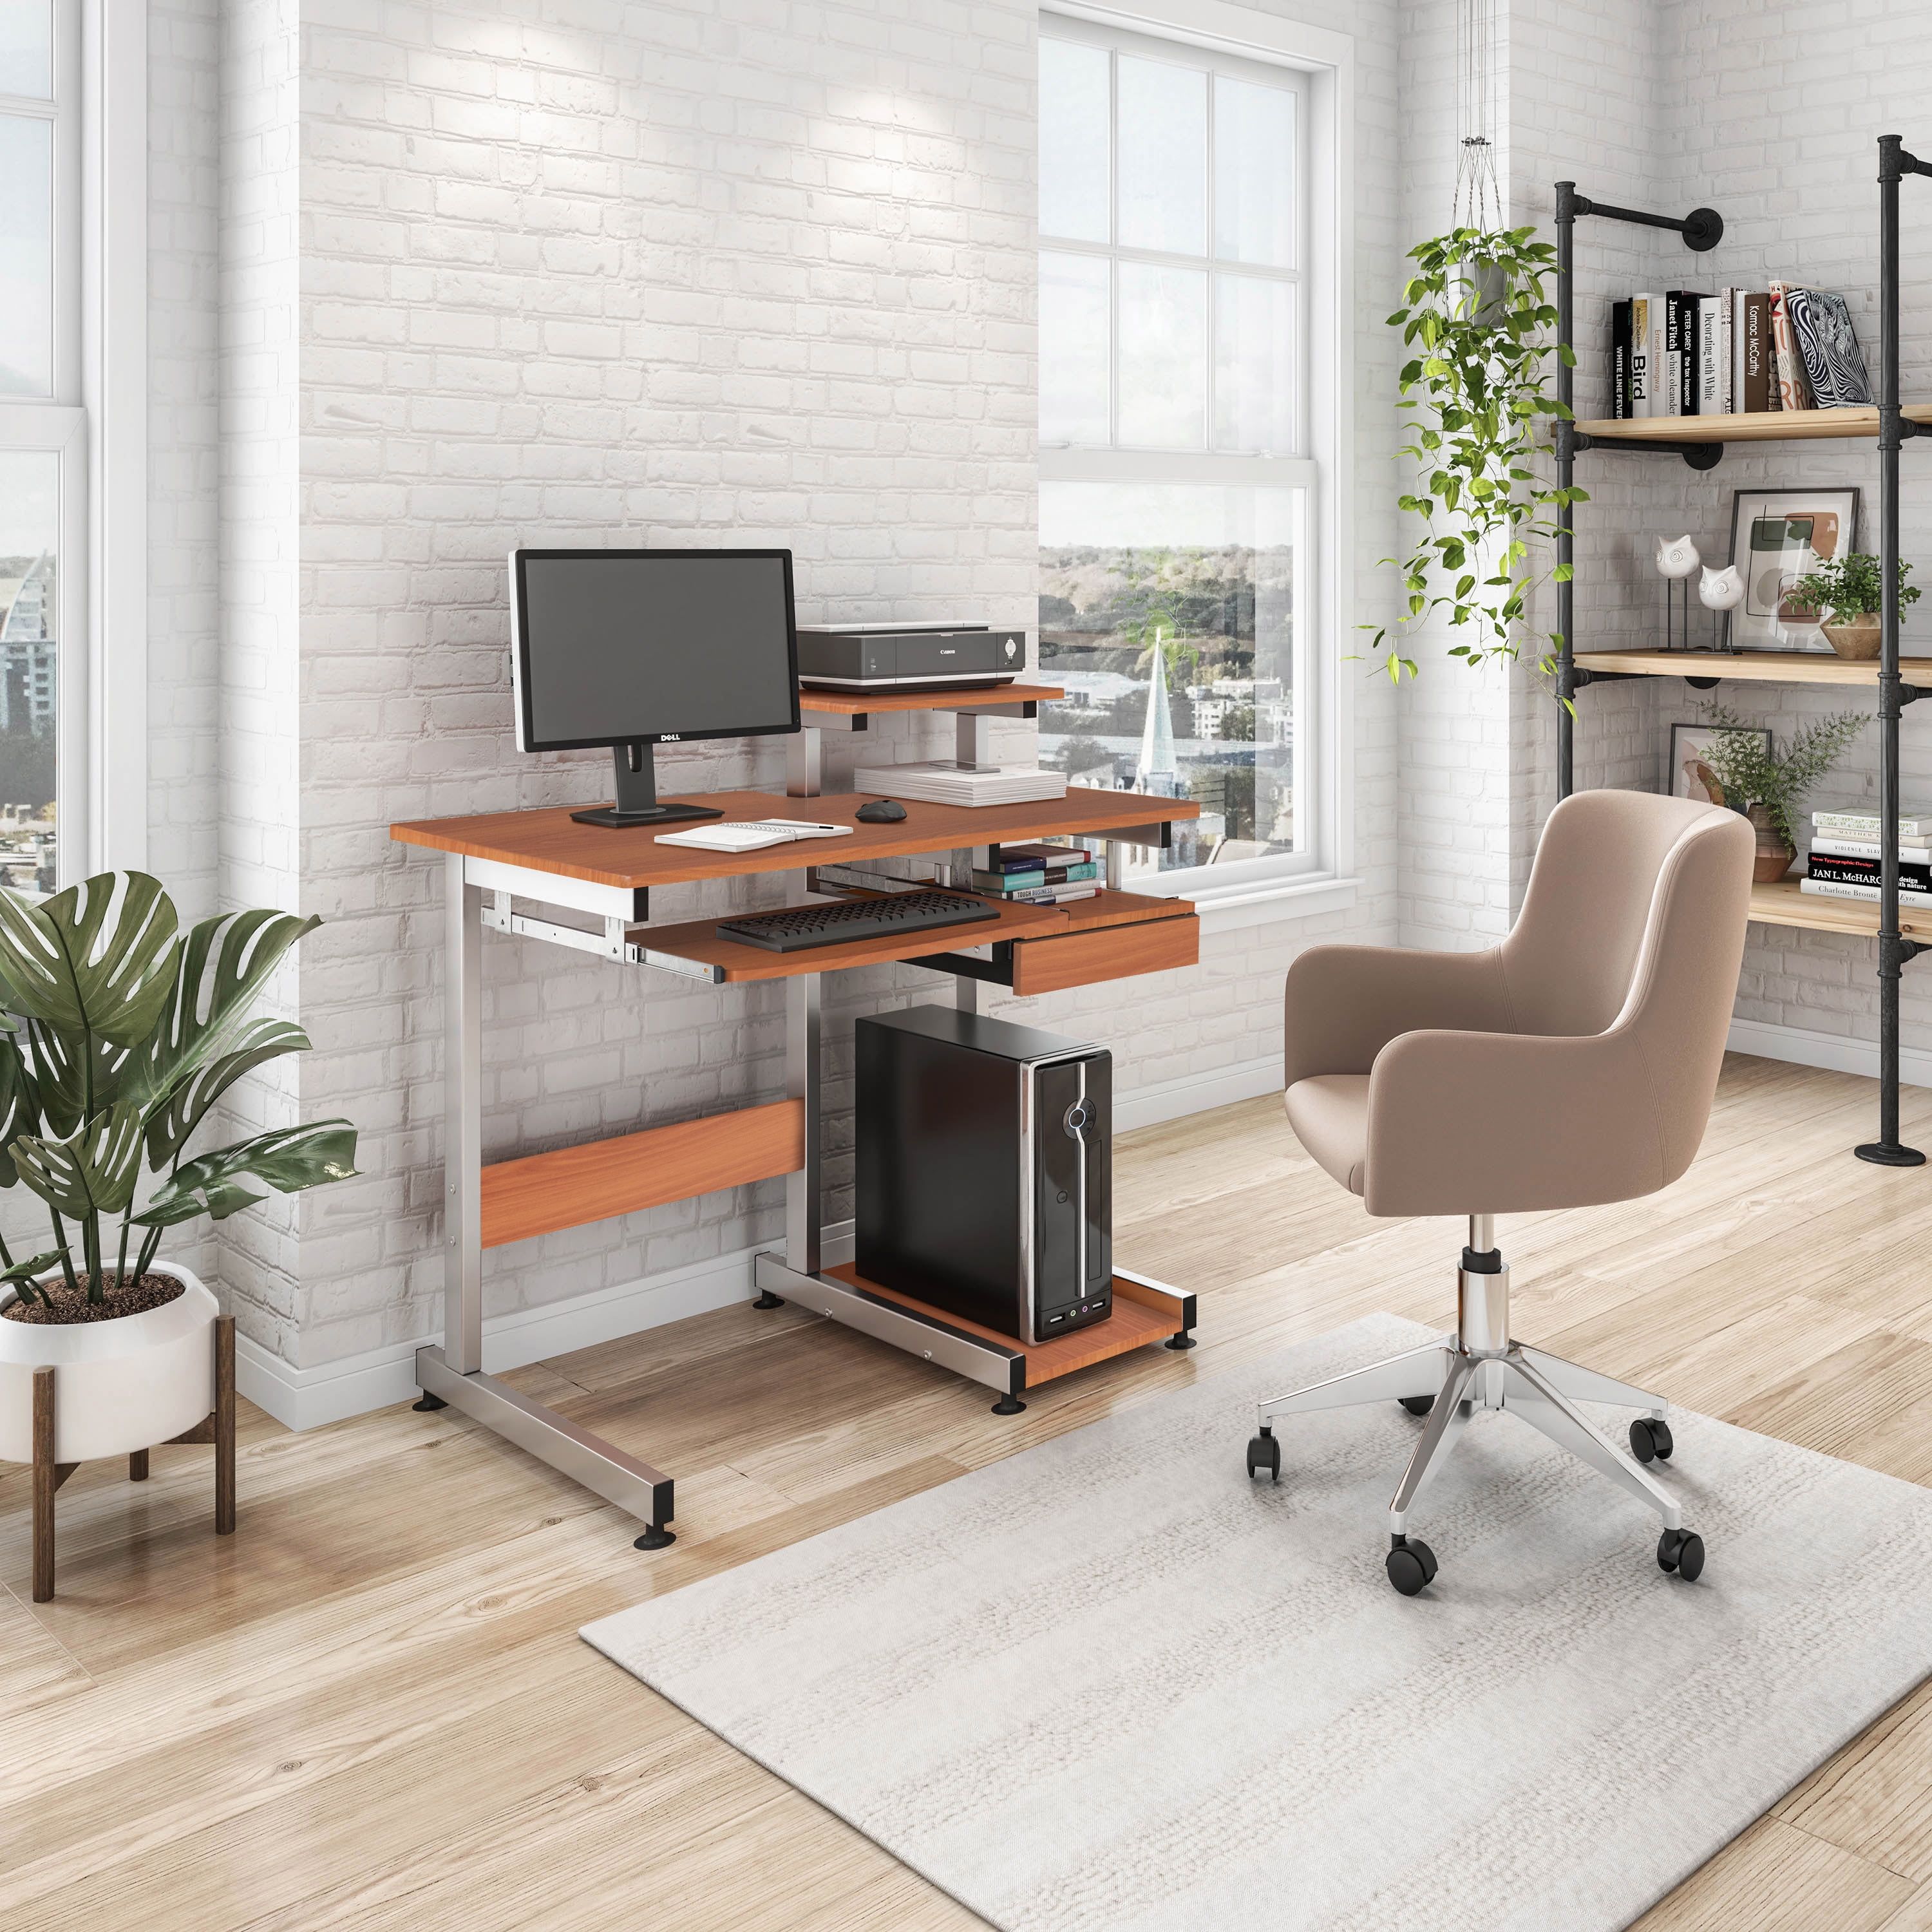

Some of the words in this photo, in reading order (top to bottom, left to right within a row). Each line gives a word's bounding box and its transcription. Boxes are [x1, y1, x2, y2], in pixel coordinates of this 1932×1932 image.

[1669, 299, 1678, 325] Janet
[1669, 326, 1678, 350] Fitch
[1702, 313, 1715, 355] Decorating
[1669, 354, 1678, 377] white
[1705, 357, 1715, 375] with
[1748, 338, 1760, 377] McCarthy
[1633, 355, 1646, 399] Bird
[1705, 377, 1715, 401] White
[1669, 379, 1678, 415] oleander
[1813, 869, 1832, 878] JAN
[1833, 871, 1841, 880] L.
[1899, 876, 1918, 884] design
[1018, 890, 1032, 898] TOUGH
[1032, 887, 1053, 896] BUSINESS
[1819, 886, 1852, 896] Charlotte
[1853, 889, 1878, 899] Brontë
[1900, 894, 1917, 903] Eyre
